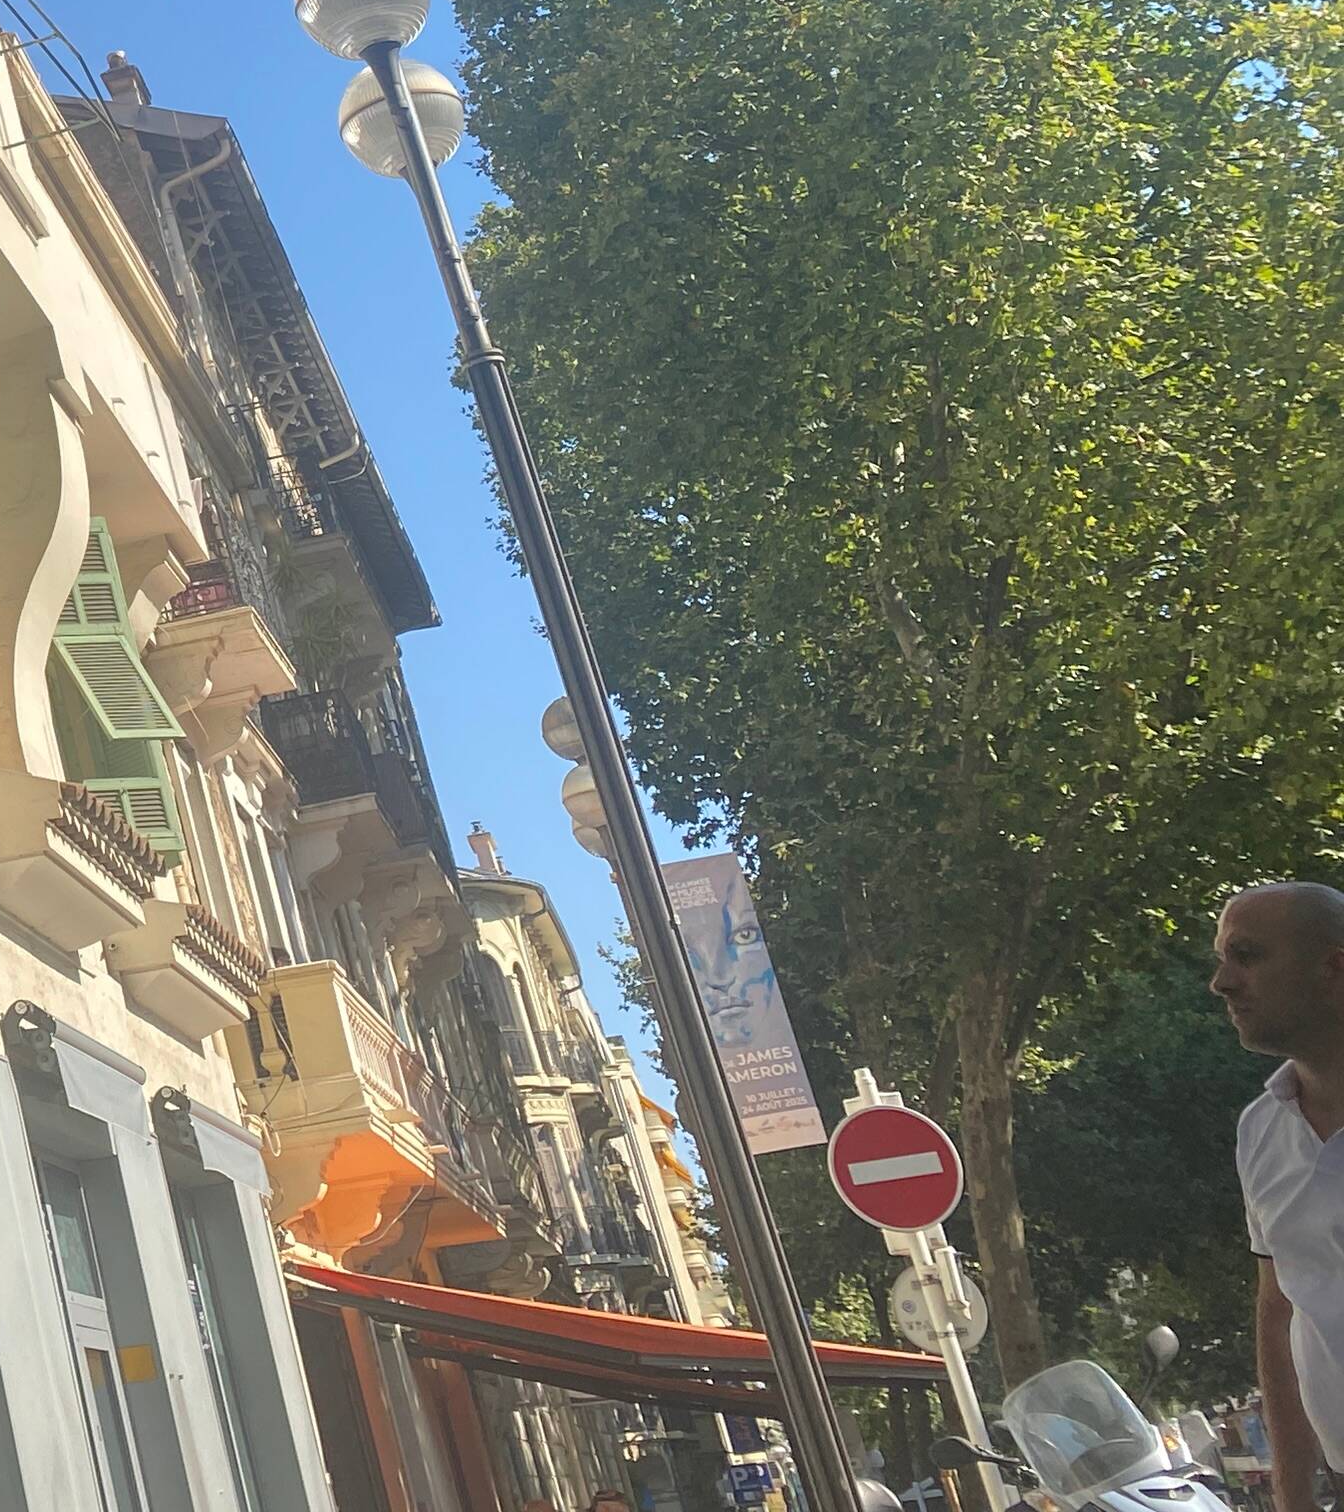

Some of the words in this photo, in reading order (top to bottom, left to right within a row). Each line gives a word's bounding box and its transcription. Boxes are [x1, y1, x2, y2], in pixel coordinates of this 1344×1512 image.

[736, 1046, 793, 1066] JAMES
[725, 1061, 798, 1084] AMERON
[757, 1087, 796, 1102] JUILLET
